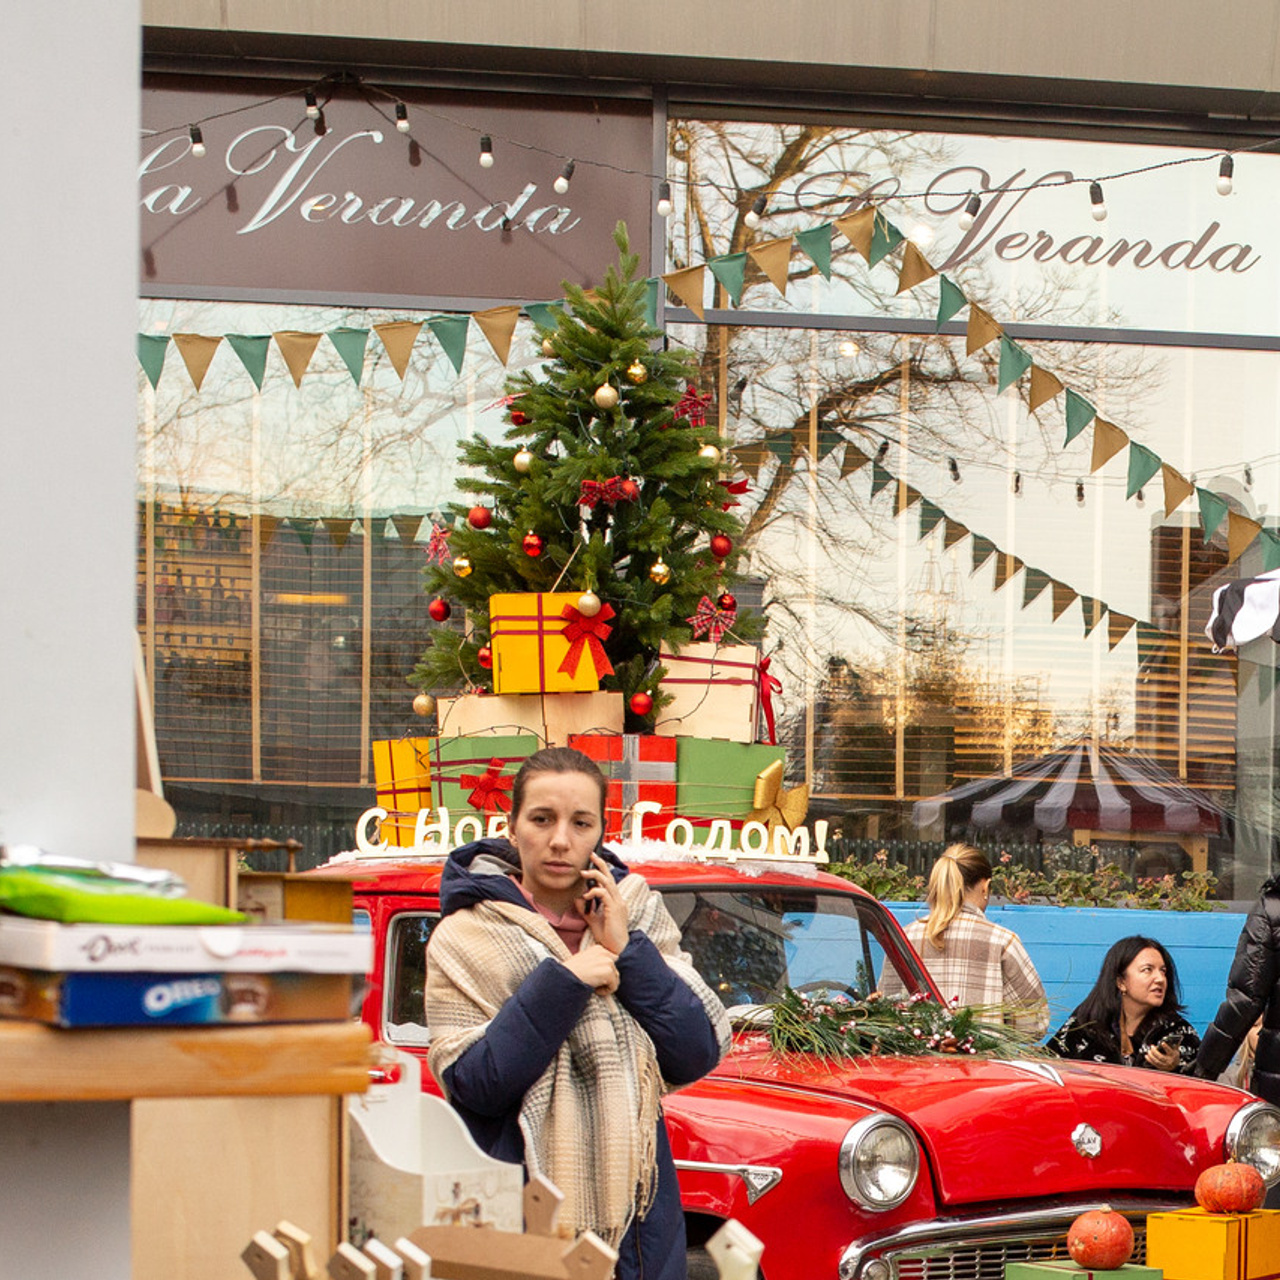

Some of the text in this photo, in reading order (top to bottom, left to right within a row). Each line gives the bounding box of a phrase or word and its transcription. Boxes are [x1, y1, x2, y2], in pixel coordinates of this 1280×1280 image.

[226, 124, 581, 235] Veranda
[924, 165, 1261, 272] Veranda
[413, 806, 510, 850] Нов
[631, 800, 830, 864] Годом!
